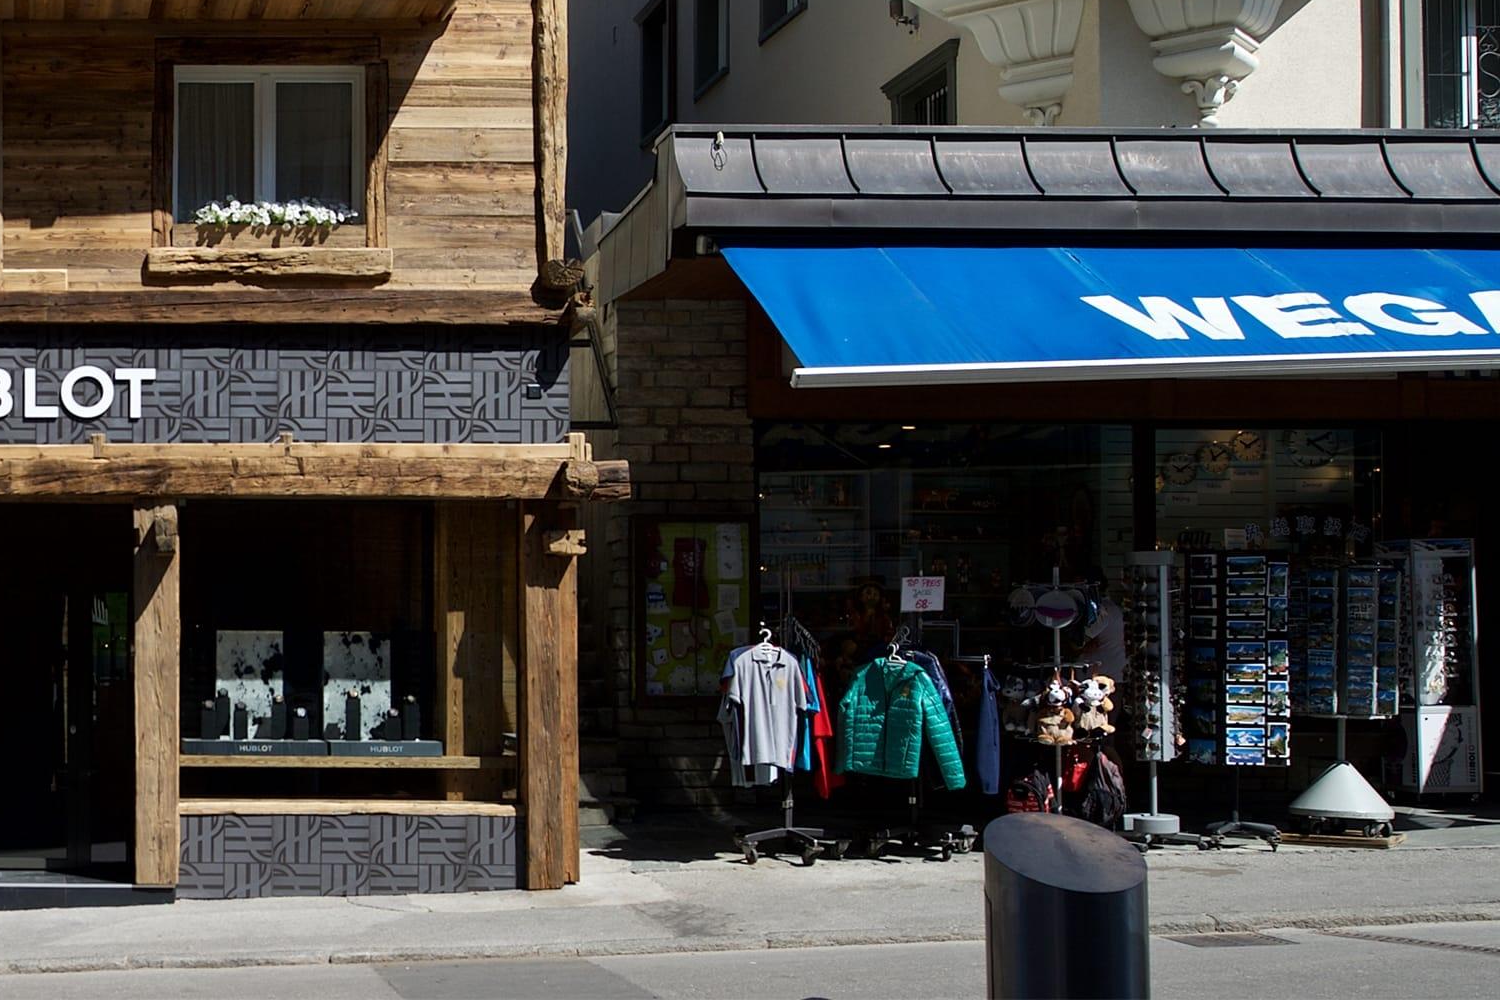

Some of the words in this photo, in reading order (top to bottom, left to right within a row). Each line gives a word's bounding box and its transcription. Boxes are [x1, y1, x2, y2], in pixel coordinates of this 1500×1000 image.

[1079, 292, 1500, 340] WEG
[239, 744, 273, 753] HUBLOT
[369, 744, 404, 753] HUBLOT
